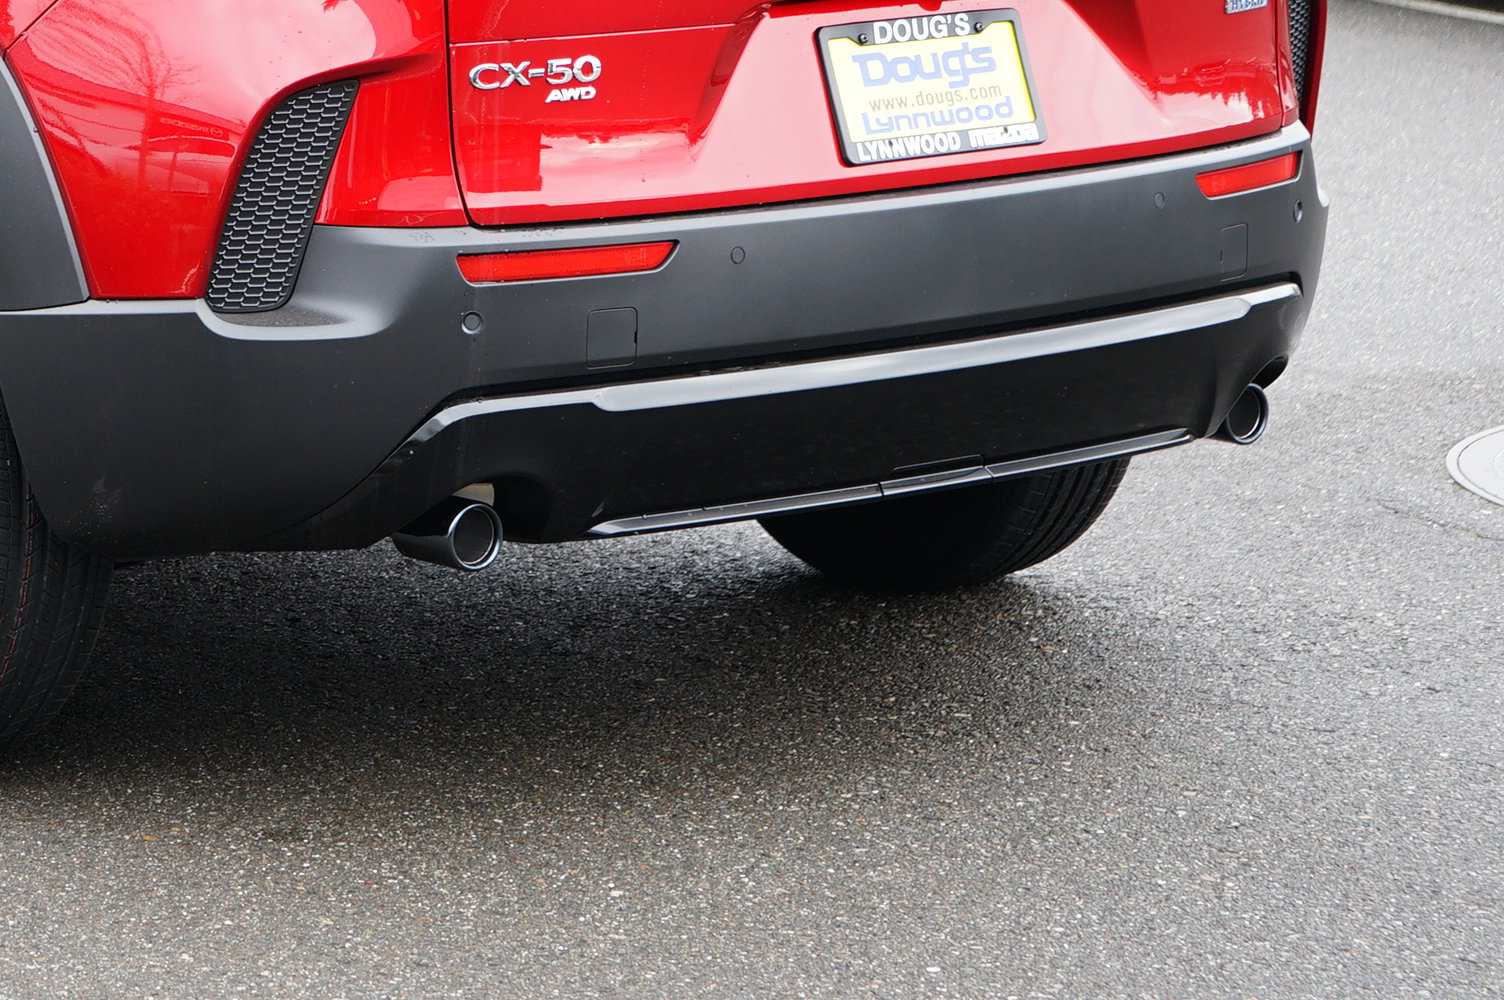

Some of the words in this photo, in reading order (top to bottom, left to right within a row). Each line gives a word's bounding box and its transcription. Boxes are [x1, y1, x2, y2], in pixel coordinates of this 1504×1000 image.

[872, 13, 971, 45] DOUG'S
[468, 54, 602, 90] CX-50
[852, 42, 998, 89] Doug's
[545, 85, 597, 103] AWD
[868, 83, 1003, 113] www.dougs.com
[860, 96, 1015, 135] Lynnwood
[856, 132, 962, 162] LYNNWOOD
